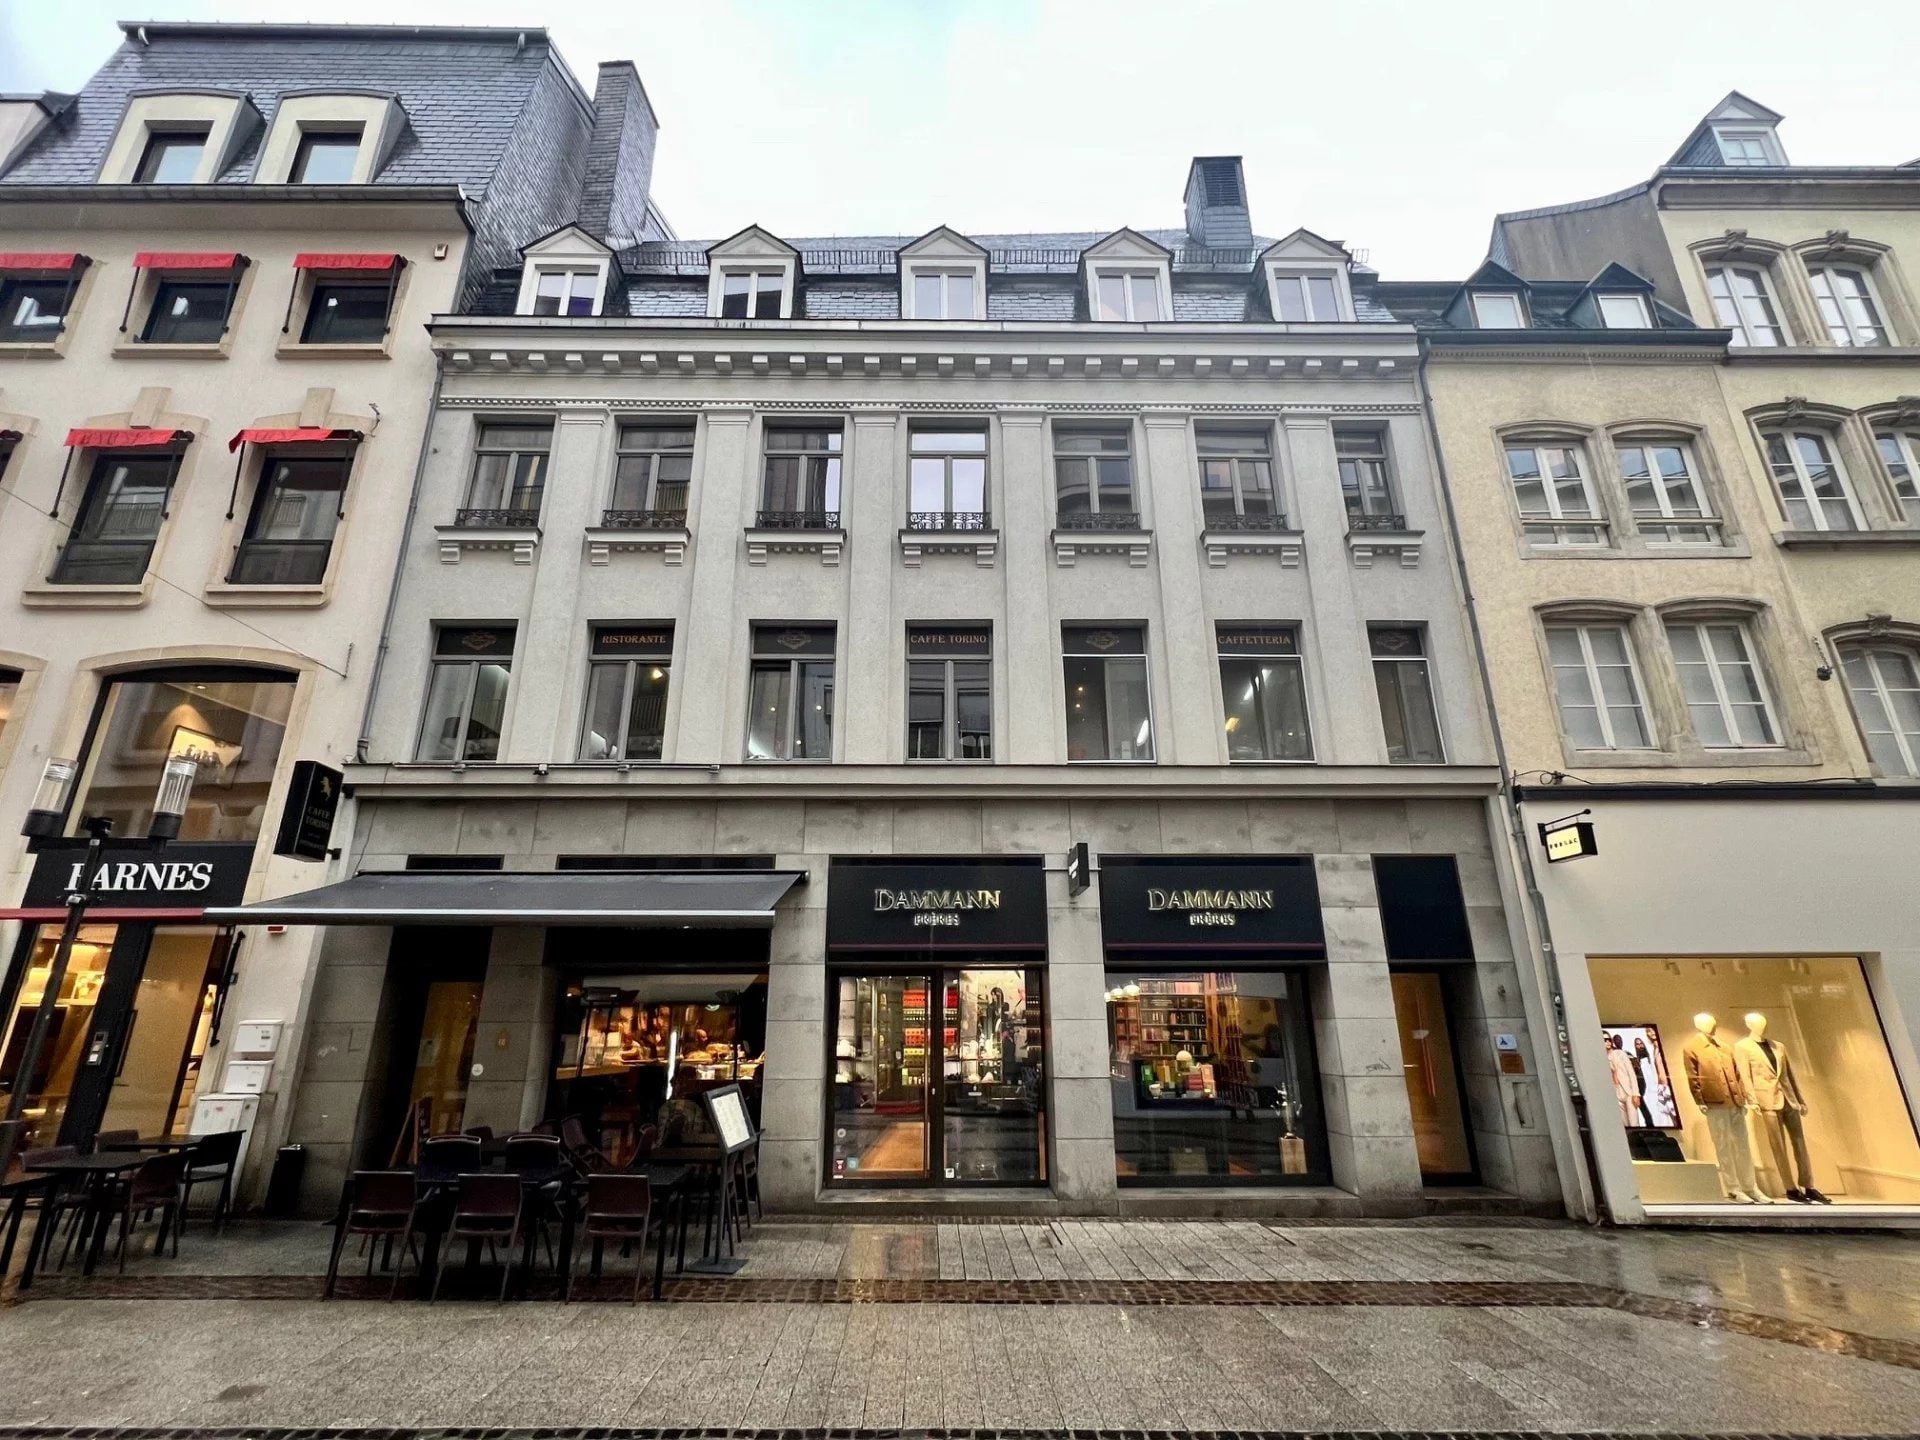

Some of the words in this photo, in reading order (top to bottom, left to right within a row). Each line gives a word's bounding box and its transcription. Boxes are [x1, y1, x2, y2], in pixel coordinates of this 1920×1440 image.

[602, 635, 667, 644] RISTORANTE
[948, 634, 987, 644] TORINO
[1217, 635, 1292, 645] CAFFETTERIA
[874, 888, 1001, 911] DAMMANN
[1147, 888, 1274, 911] DAMMANN
